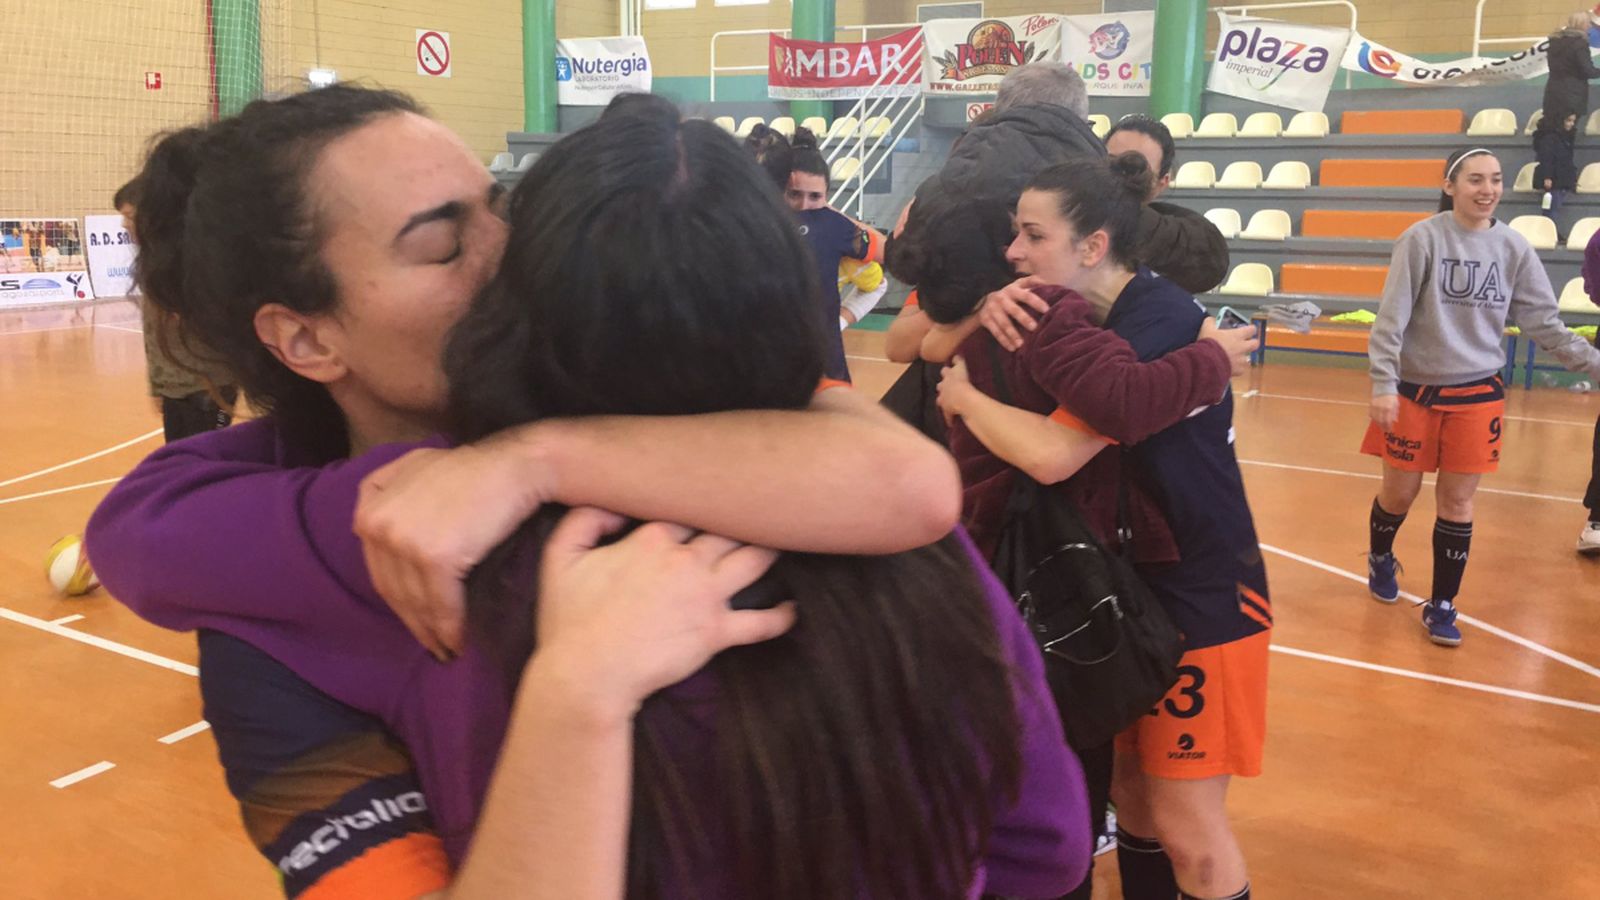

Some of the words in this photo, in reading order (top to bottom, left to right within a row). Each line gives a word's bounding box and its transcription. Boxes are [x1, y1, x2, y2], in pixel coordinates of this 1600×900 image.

[572, 52, 647, 77] Nutergia
[1218, 27, 1329, 73] plaza
[1225, 60, 1273, 78] imperial
[1441, 258, 1506, 302] UA
[1488, 416, 1501, 445] 9
